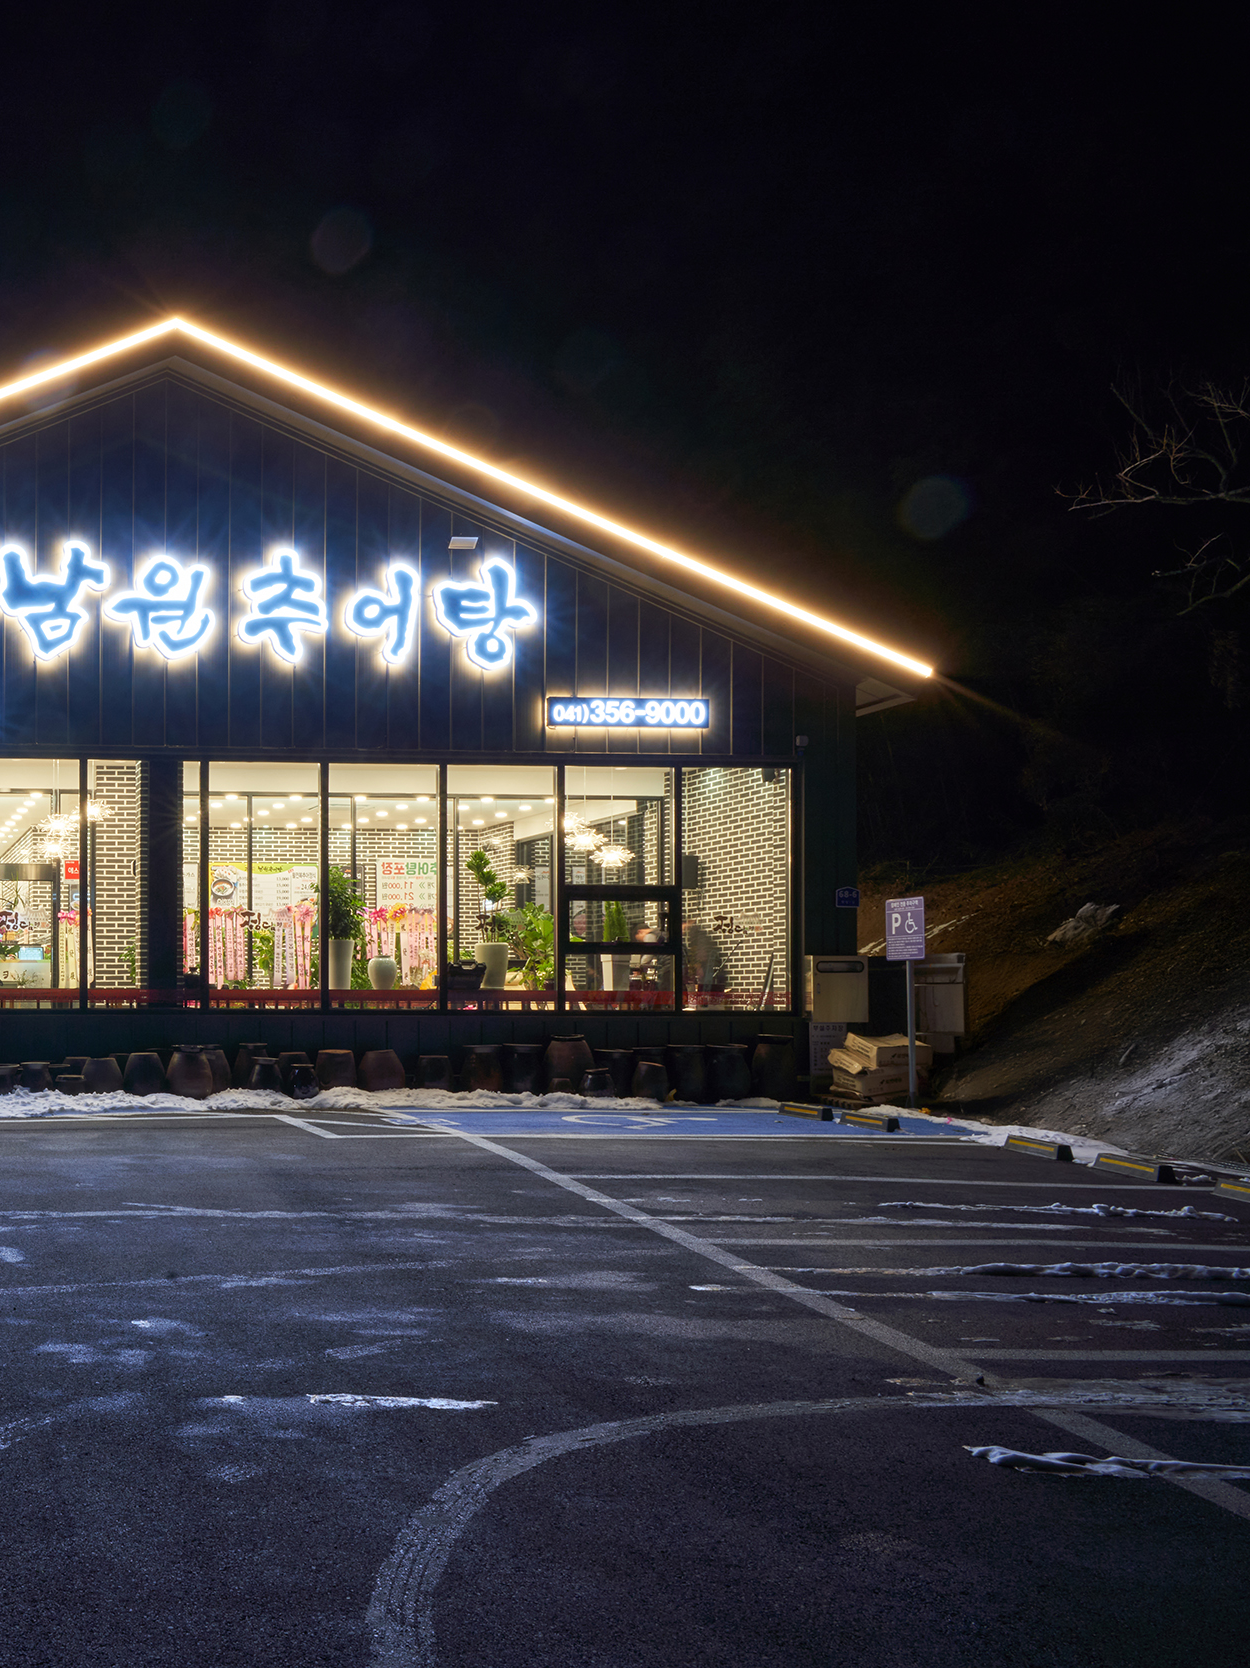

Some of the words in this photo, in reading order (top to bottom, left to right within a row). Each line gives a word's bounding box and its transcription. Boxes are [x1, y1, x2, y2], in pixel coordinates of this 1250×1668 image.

[0, 542, 539, 670] 남원추어탕
[839, 891, 857, 899] 68-6
[891, 913, 902, 935] P
